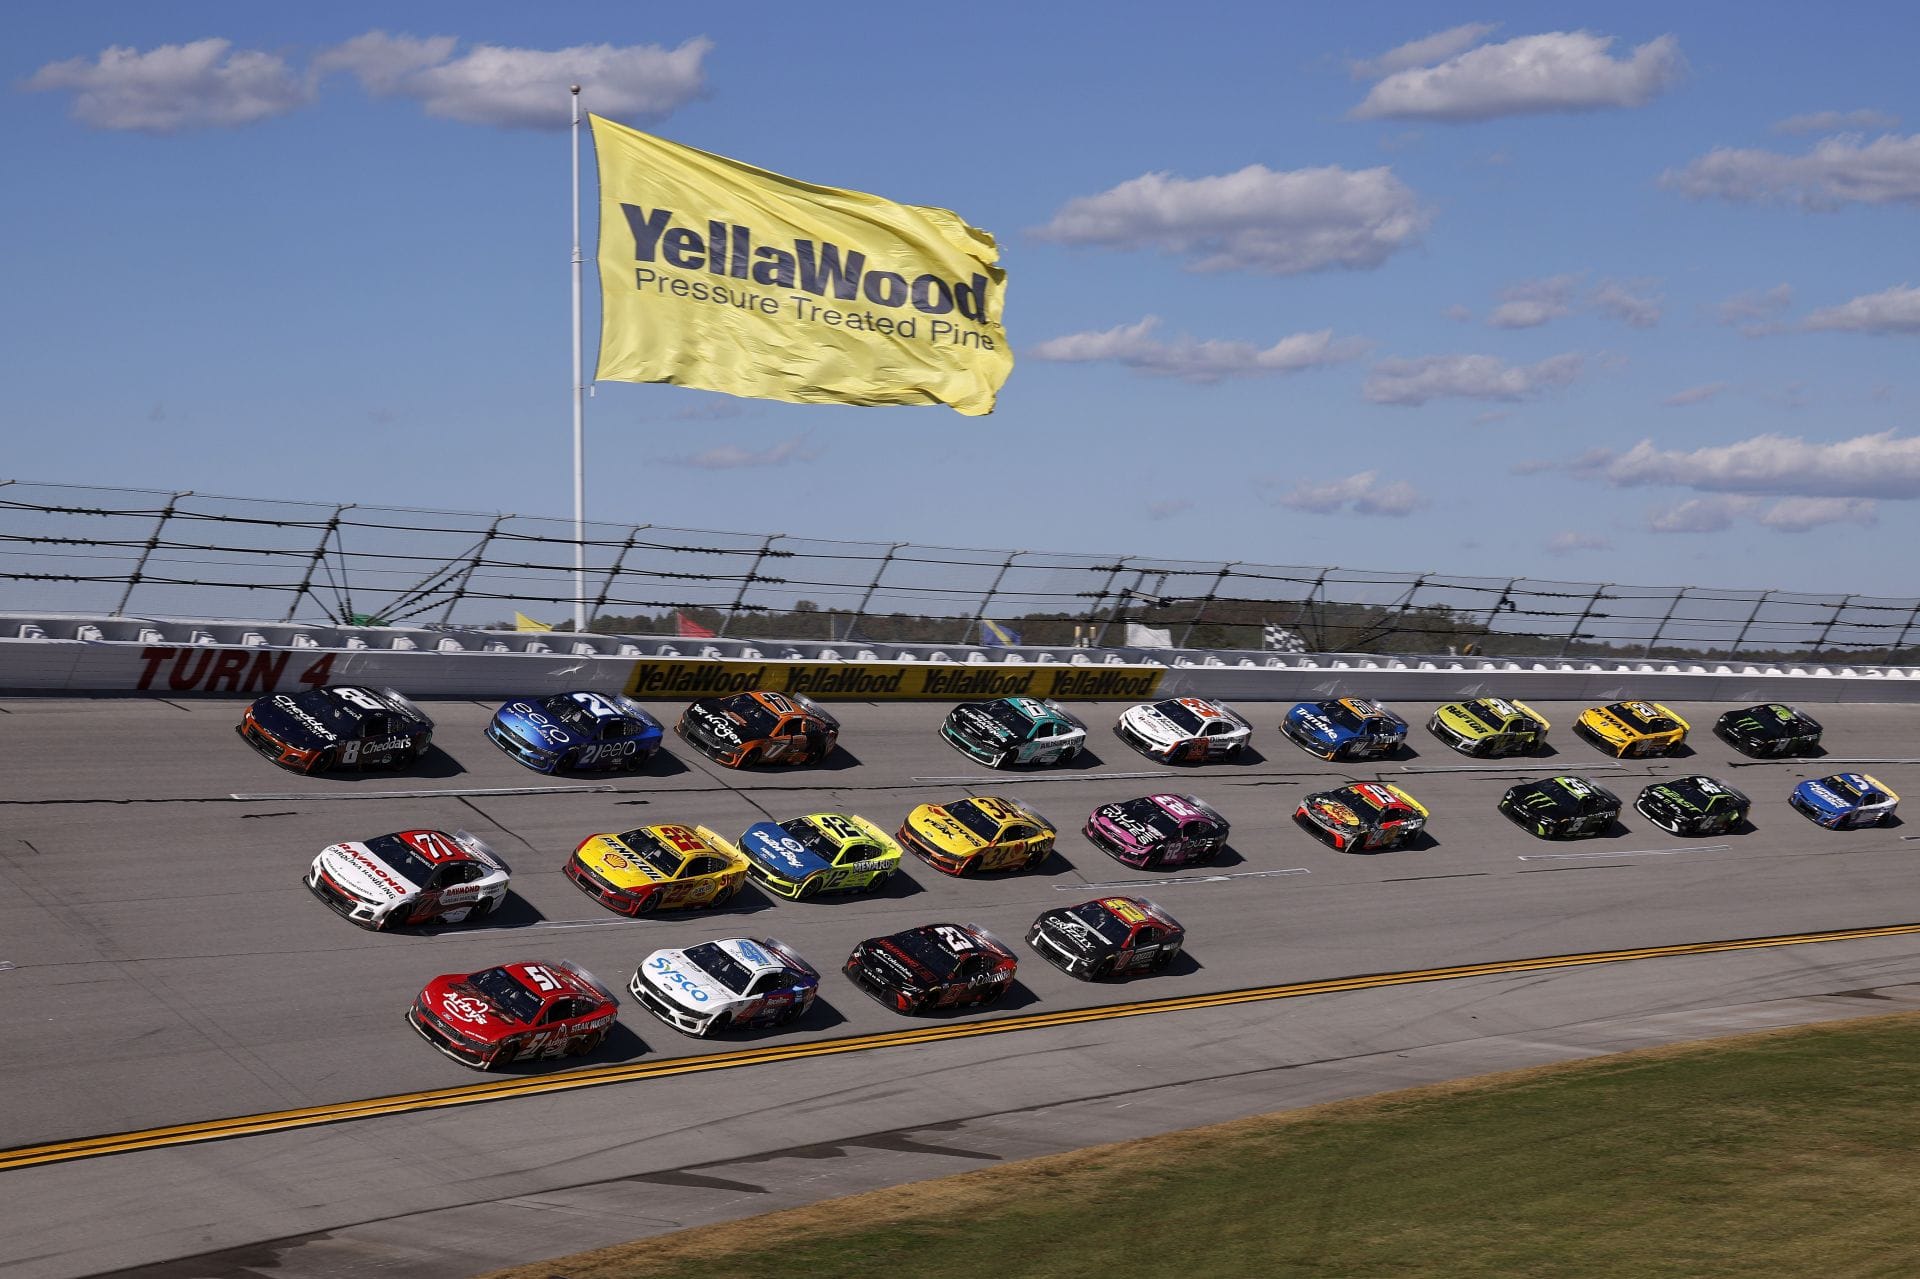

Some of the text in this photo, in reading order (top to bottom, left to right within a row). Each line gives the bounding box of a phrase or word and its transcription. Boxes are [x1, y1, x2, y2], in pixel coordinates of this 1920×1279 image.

[620, 203, 988, 325] YellaWood
[635, 268, 995, 350] Pressure Treated Pine
[136, 648, 337, 691] TURN 4
[634, 664, 766, 693] YellaWood
[785, 666, 905, 693] YellaWood
[921, 669, 1037, 694] YellaWood
[1050, 671, 1155, 695] YellaWood
[333, 687, 387, 710] 8
[572, 693, 624, 716] 21
[761, 692, 794, 713] 17
[512, 702, 570, 743] eero
[1296, 707, 1338, 742] Trimble
[342, 741, 361, 764] 8
[362, 735, 412, 755] Cheddar's
[579, 742, 603, 764] 21
[600, 740, 636, 758] eero
[1364, 784, 1397, 804] 19
[1849, 774, 1869, 791] 5
[660, 827, 706, 851] 22
[821, 816, 862, 838] 12
[923, 818, 954, 840] PEAK
[413, 833, 453, 858] 71
[337, 843, 408, 895] RAYMOND
[599, 836, 664, 882] PENNZOIL
[824, 871, 849, 888] 12
[935, 926, 974, 952] 23
[1049, 916, 1096, 950] GRIZZLY
[524, 966, 562, 991] 51
[443, 991, 488, 1025] Arby's
